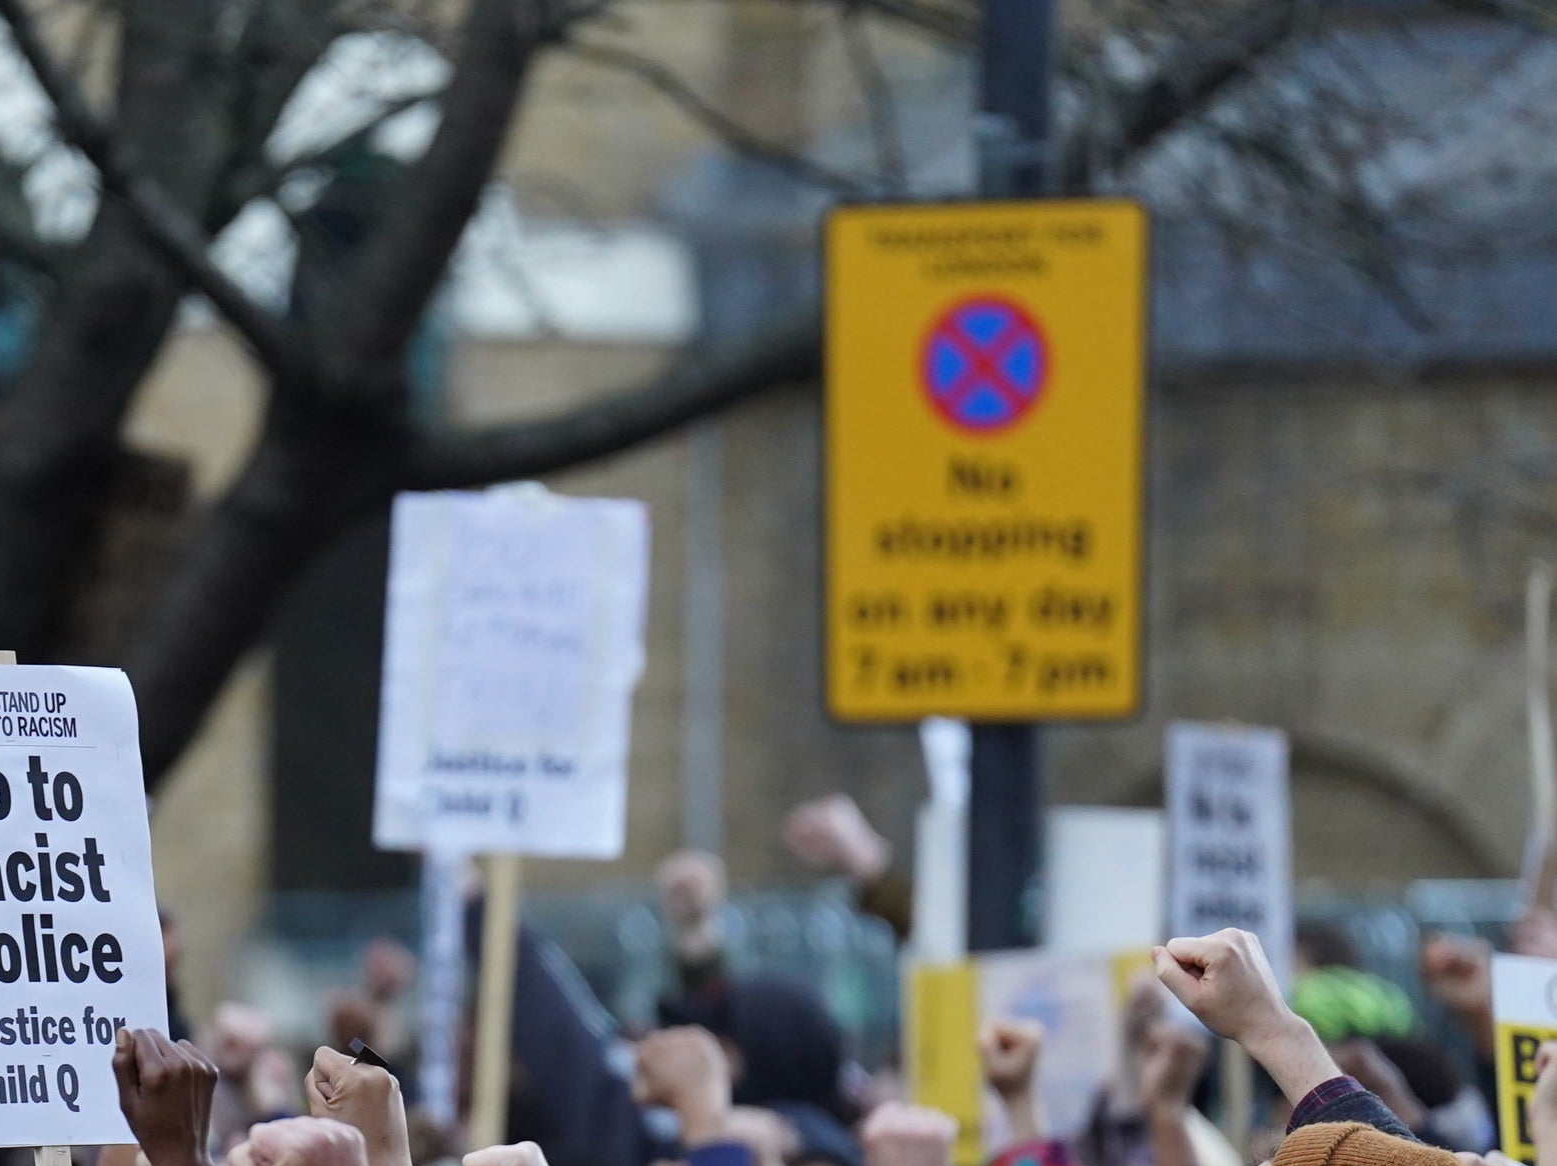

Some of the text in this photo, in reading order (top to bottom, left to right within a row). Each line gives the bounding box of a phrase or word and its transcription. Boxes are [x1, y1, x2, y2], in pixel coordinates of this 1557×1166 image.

[949, 460, 1017, 498] No
[876, 513, 1090, 565] stopping
[852, 584, 1112, 635] on any day
[44, 692, 66, 713] UP
[17, 716, 77, 738] RACISM
[27, 755, 83, 822] to
[83, 1005, 126, 1046] for
[57, 1063, 80, 1112] Q
